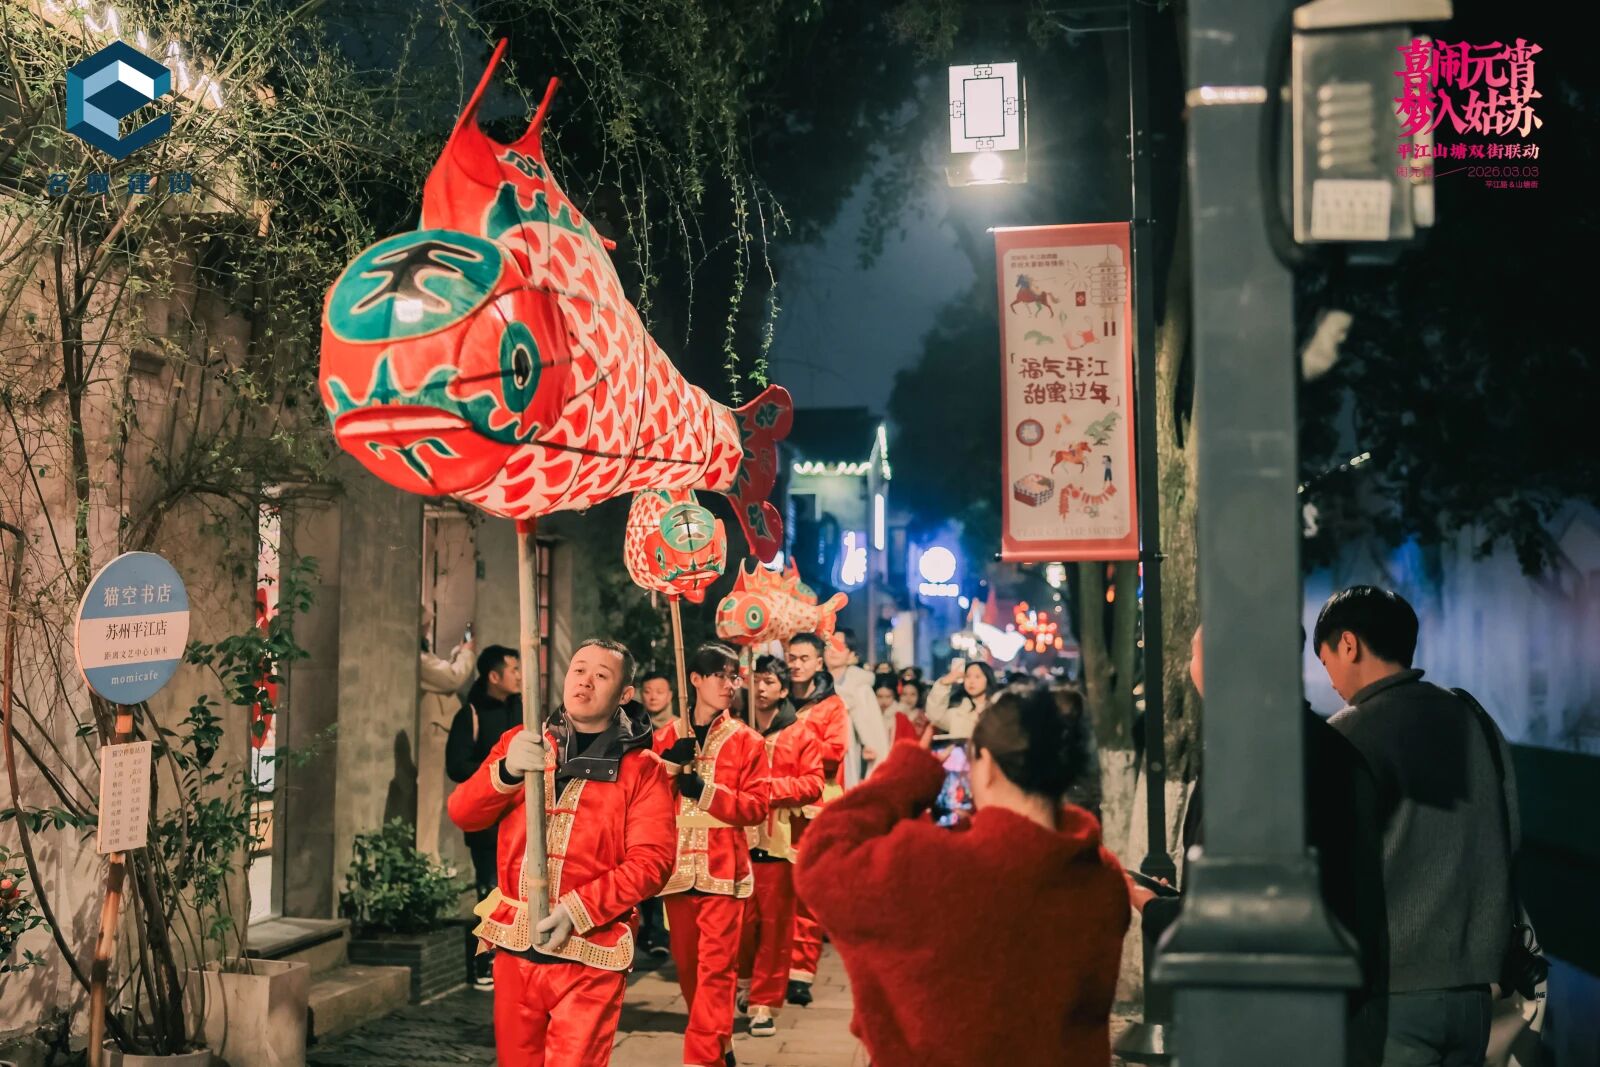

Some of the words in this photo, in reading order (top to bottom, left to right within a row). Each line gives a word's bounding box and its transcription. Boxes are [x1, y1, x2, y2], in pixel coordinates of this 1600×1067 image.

[103, 583, 172, 608] 猫空书店
[105, 620, 168, 641] 苏州平江店
[111, 670, 159, 686] momicafe
